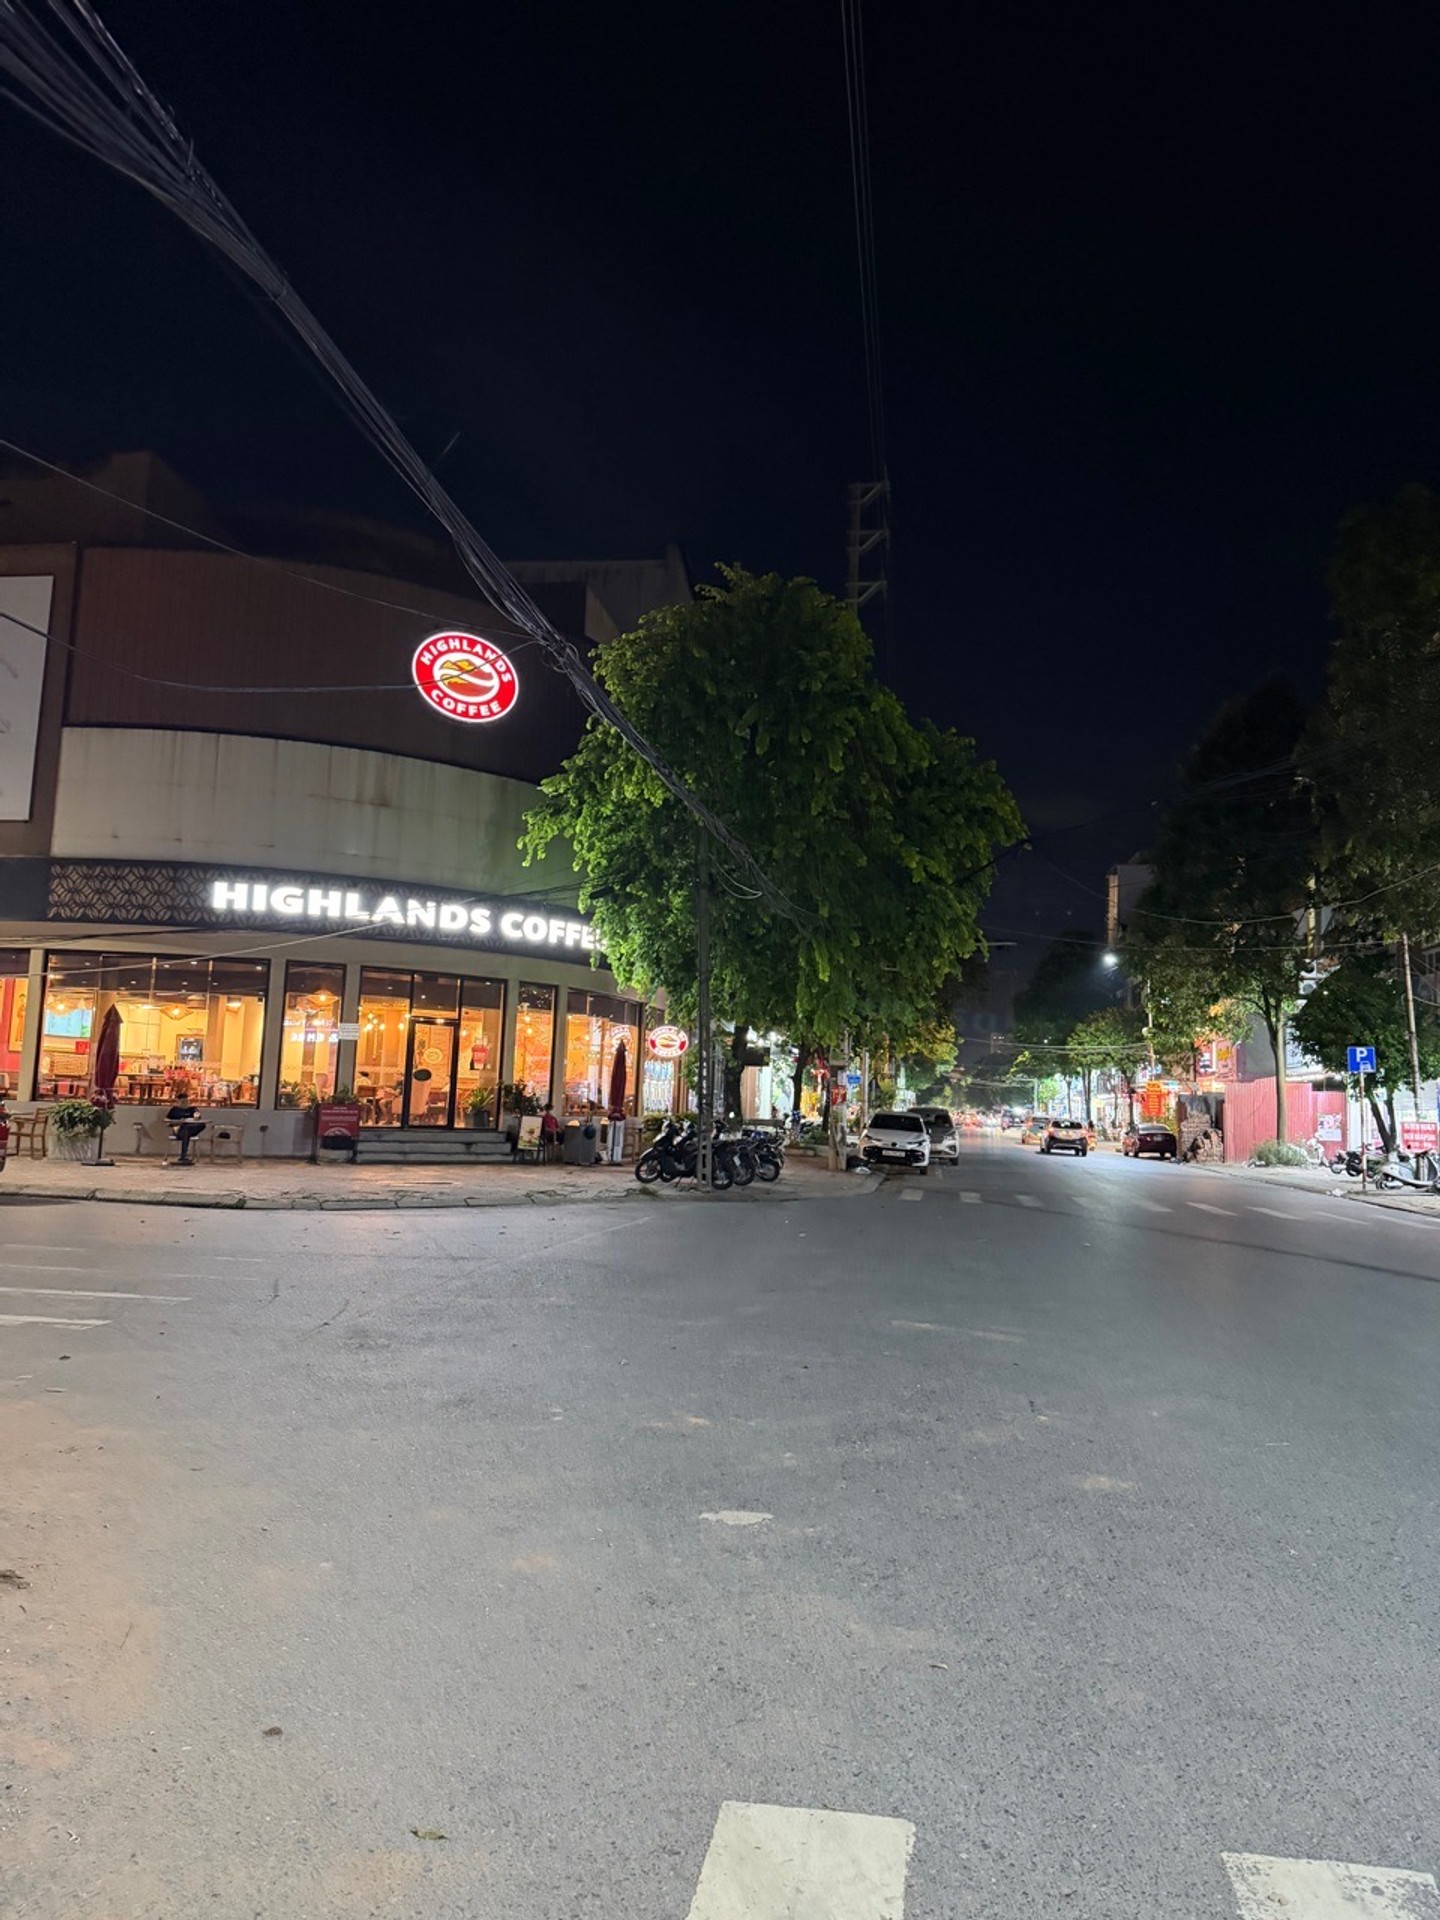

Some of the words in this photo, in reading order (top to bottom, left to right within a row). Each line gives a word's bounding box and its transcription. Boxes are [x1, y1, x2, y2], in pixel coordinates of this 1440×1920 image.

[420, 638, 513, 682] HIGHLANDS
[431, 689, 502, 717] COFFEE
[212, 881, 491, 934] HIGHLANDS
[1356, 1048, 1368, 1062] P
